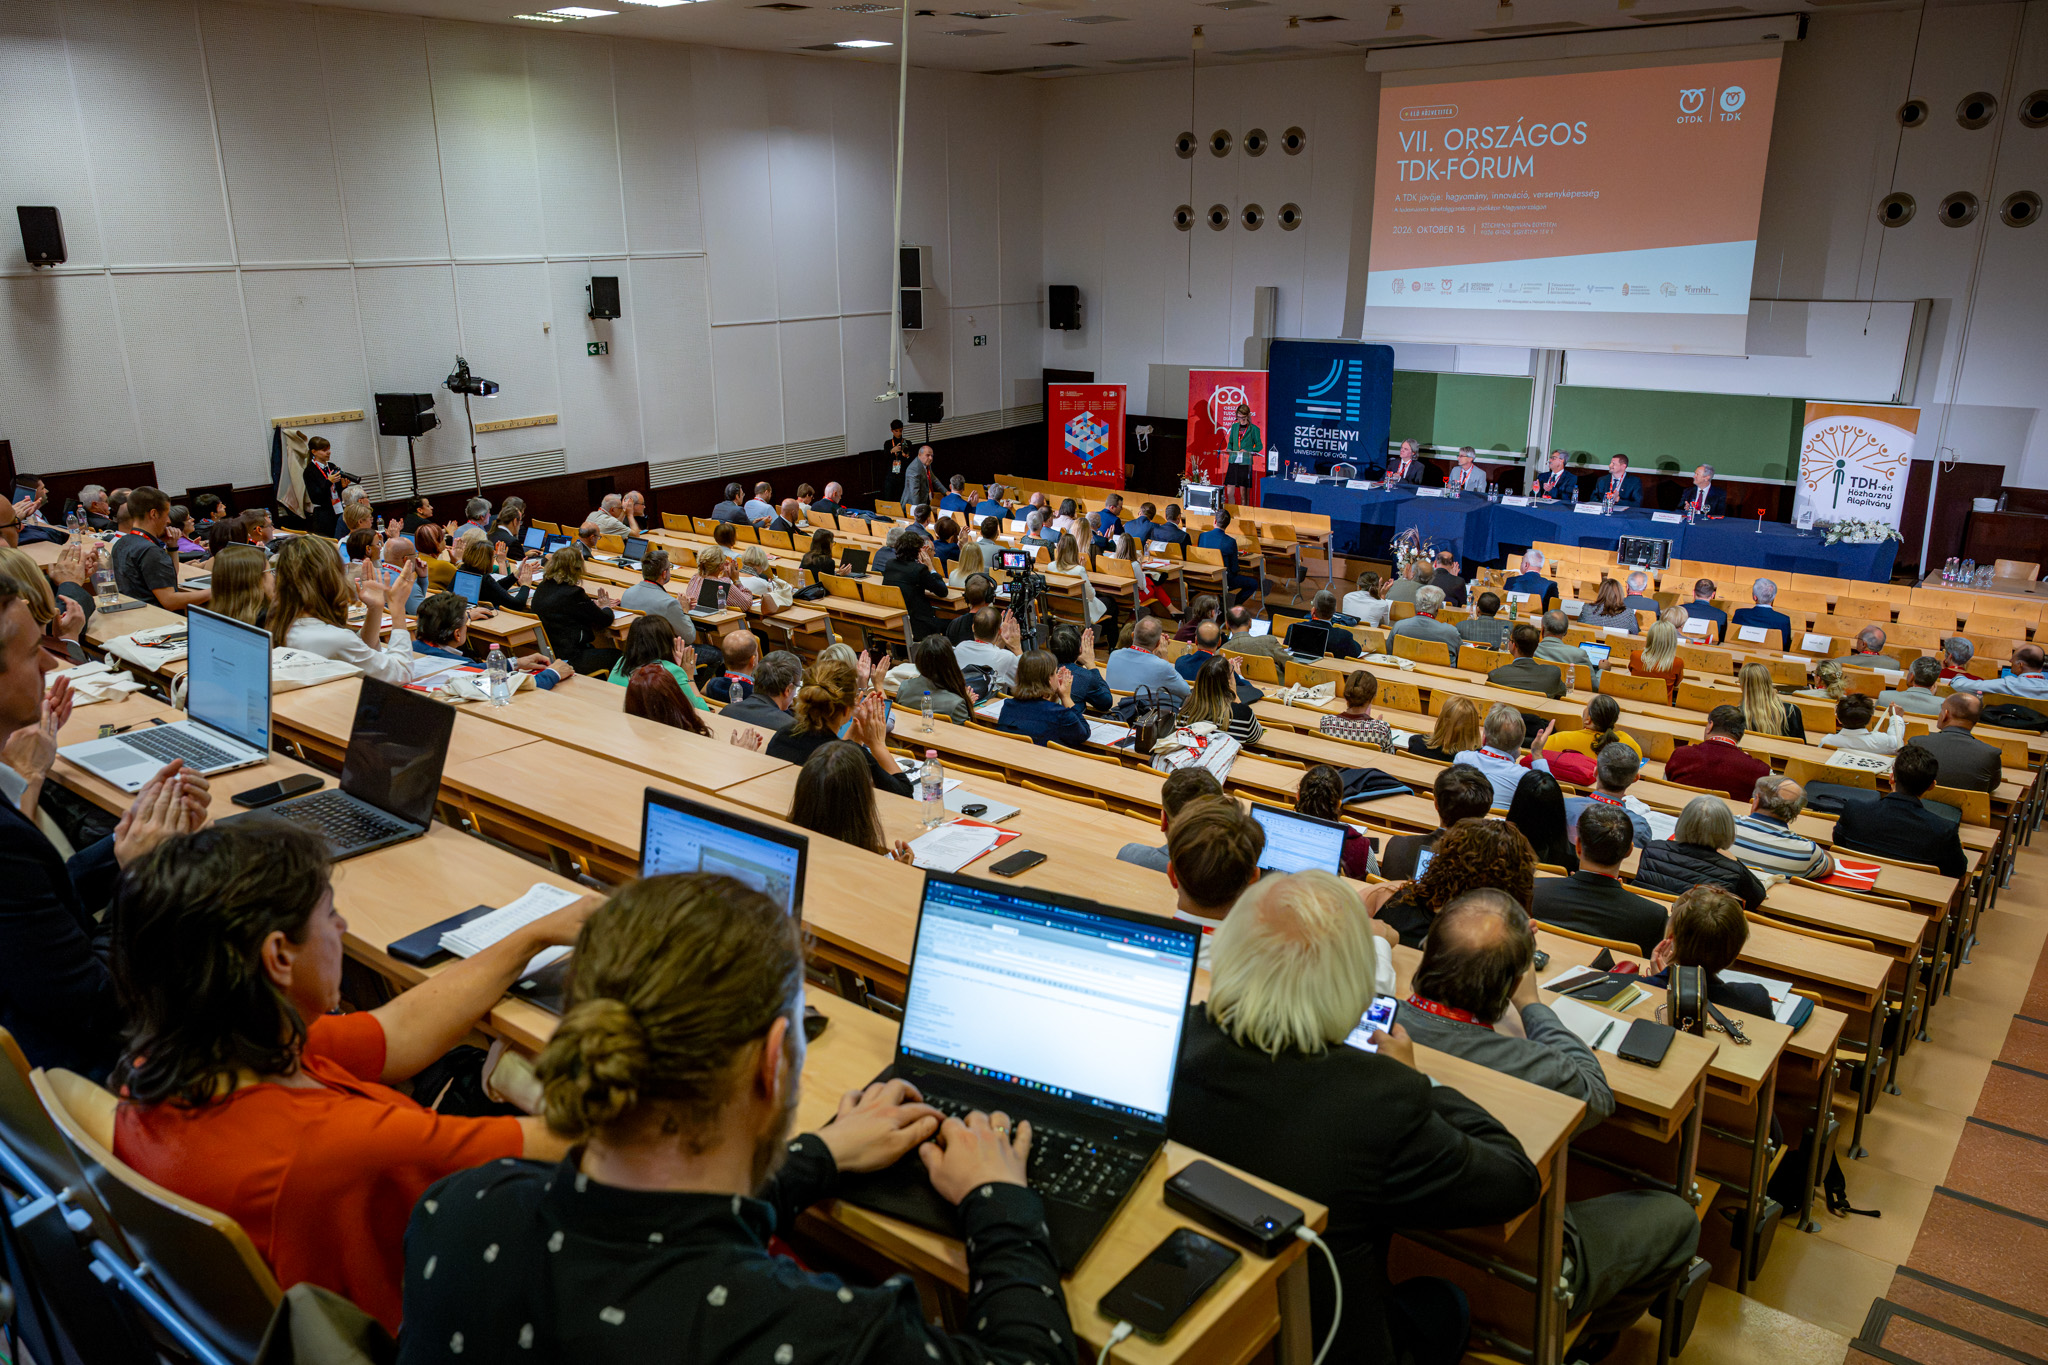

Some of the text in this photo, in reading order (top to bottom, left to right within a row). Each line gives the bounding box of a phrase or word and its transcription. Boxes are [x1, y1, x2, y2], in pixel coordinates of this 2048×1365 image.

[1676, 115, 1703, 124] OTDK
[1720, 112, 1741, 122] TDK
[1399, 116, 1587, 152] VII. ORSZÁGOS
[1397, 149, 1533, 181] TDK-FÓRUM
[1403, 193, 1417, 202] TDK
[1419, 193, 1443, 203] jövője:
[1445, 191, 1489, 203] hagyomány,
[1491, 190, 1530, 200] innováció,
[1533, 188, 1600, 199] versenyképesség
[1294, 424, 1359, 441] SZÉCHENYI
[1294, 436, 1348, 452] EGYETEM
[1293, 448, 1323, 456] UNIVERSITY
[1332, 451, 1347, 459] GYŐR
[1850, 476, 1893, 491] TDK-ért
[1847, 488, 1892, 500] Közhasznú
[1846, 496, 1891, 510] Alapítvány
